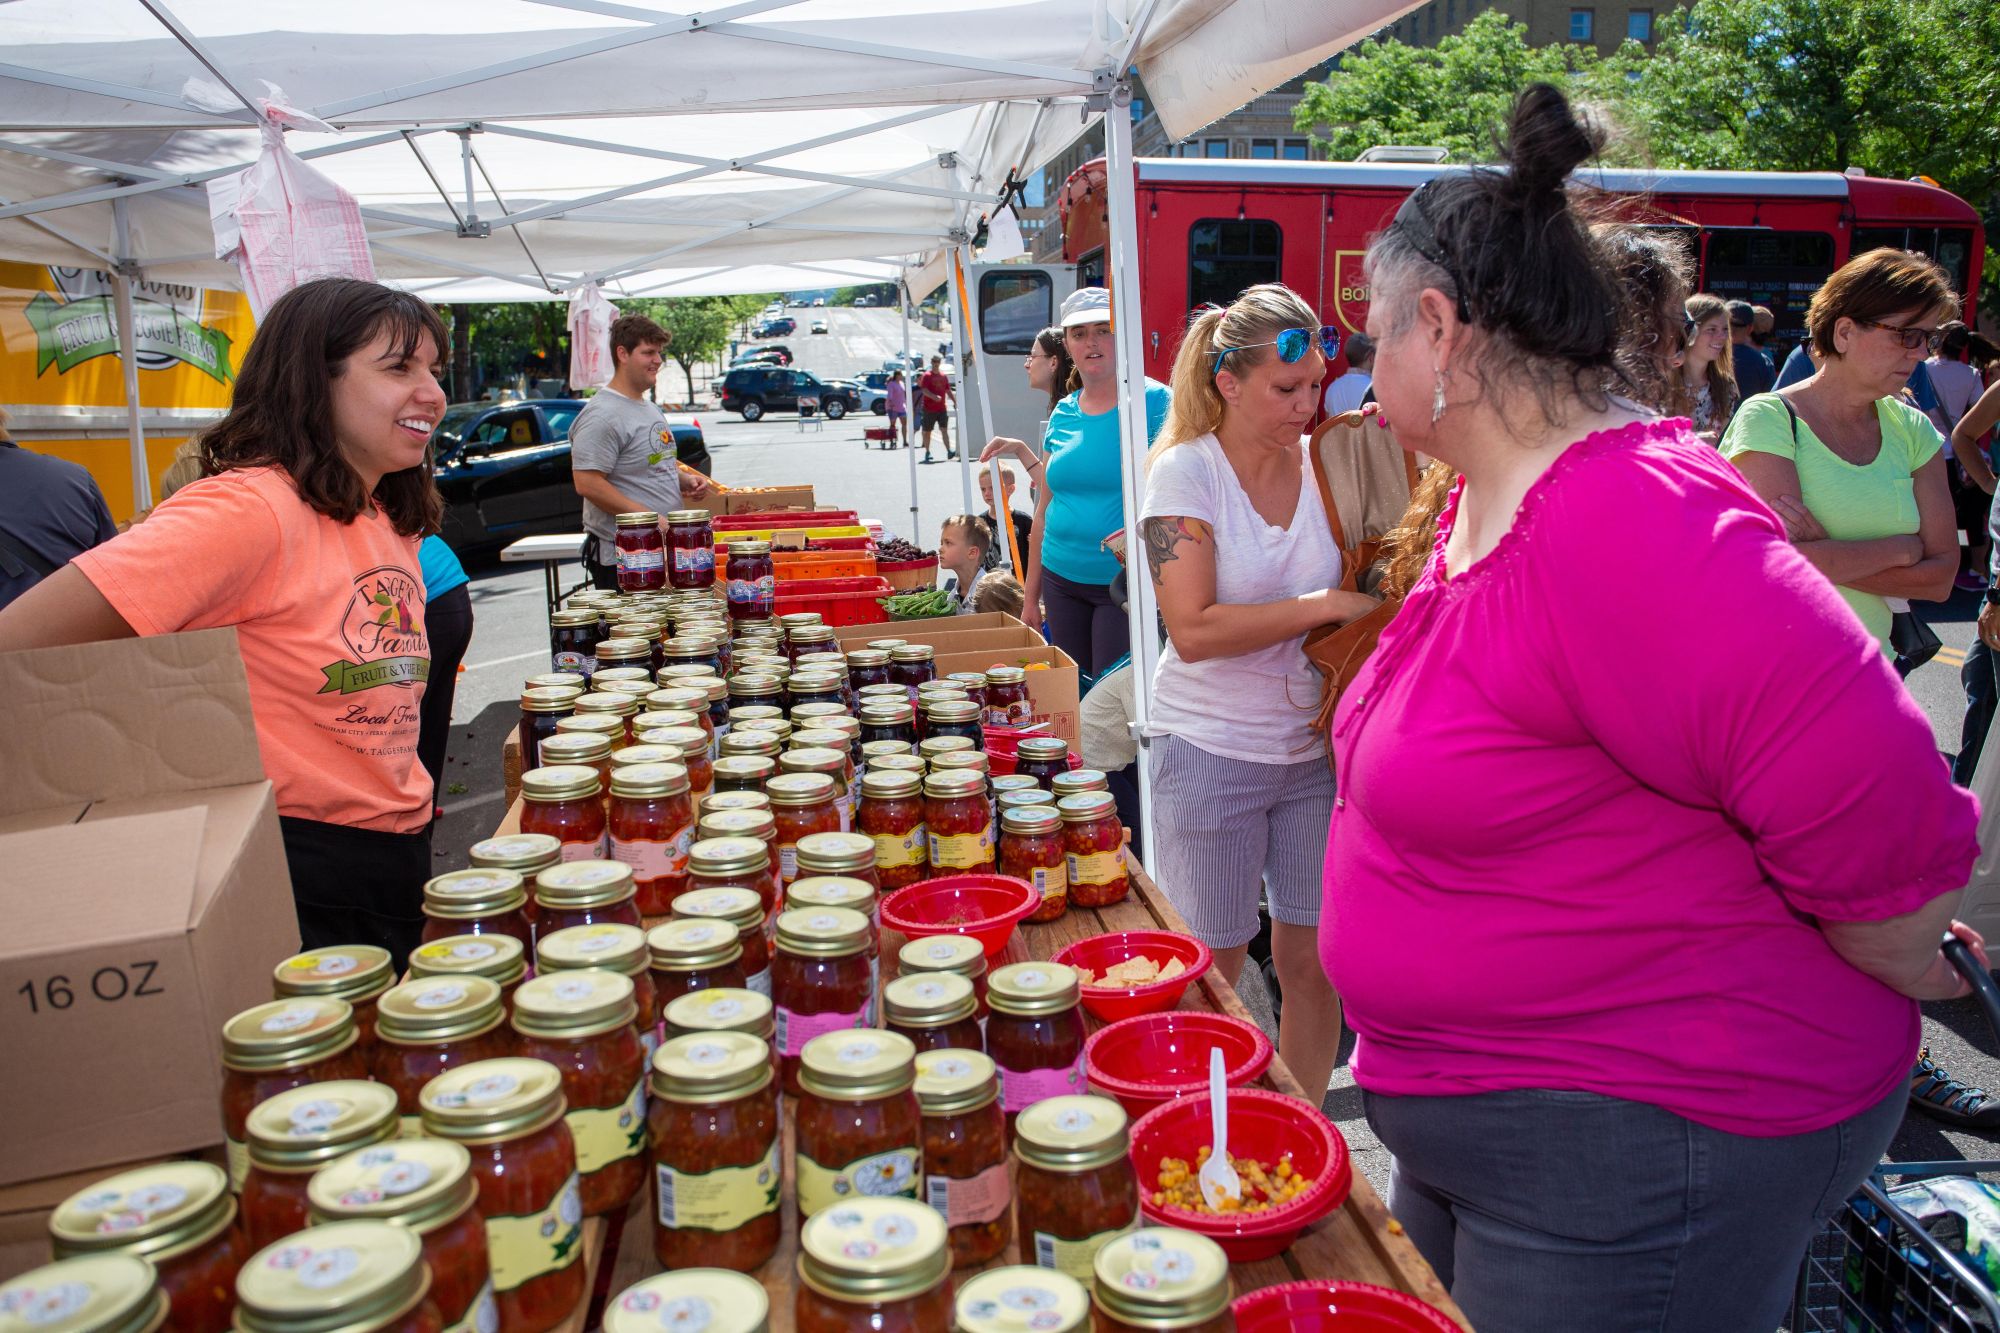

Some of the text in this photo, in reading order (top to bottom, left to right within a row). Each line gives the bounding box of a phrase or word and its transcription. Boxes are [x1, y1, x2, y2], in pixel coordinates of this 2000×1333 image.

[1342, 286, 1372, 302] BOI
[58, 315, 106, 353] FRUIT
[133, 314, 174, 345] EGGIE
[176, 325, 217, 365] FARMS
[351, 666, 388, 686] FRUIT
[389, 665, 400, 677] &
[335, 704, 397, 725] Local
[18, 960, 165, 1014] 16 OZ
